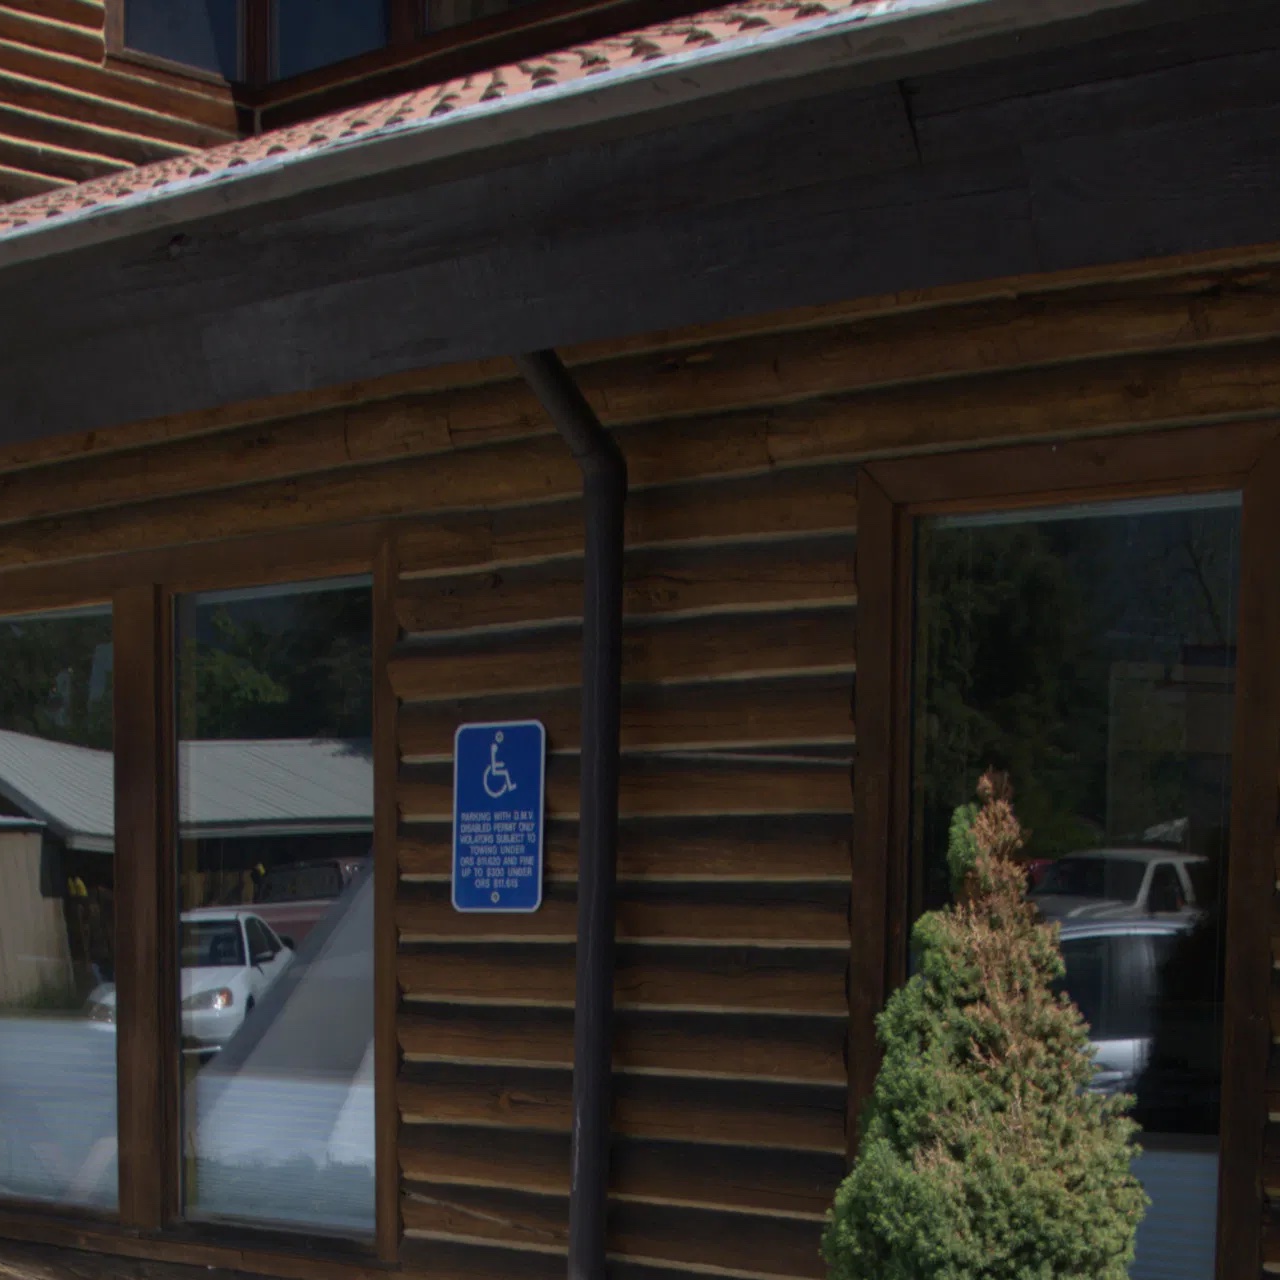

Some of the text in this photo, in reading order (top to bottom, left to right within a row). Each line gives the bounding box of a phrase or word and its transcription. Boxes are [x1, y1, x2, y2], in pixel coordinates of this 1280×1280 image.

[461, 811, 491, 821] PARKING
[493, 811, 511, 821] WITH
[460, 822, 535, 833] DISABLED PERMIT ONLY
[460, 833, 536, 844] VIOLATORS SUBJECT TO
[469, 844, 525, 855] TOWING UNDER
[503, 856, 517, 866] AND
[519, 856, 534, 866] FINE
[461, 868, 471, 878] UP
[474, 868, 483, 877] TO
[507, 867, 532, 877] UNDER
[474, 879, 490, 888] ORS
